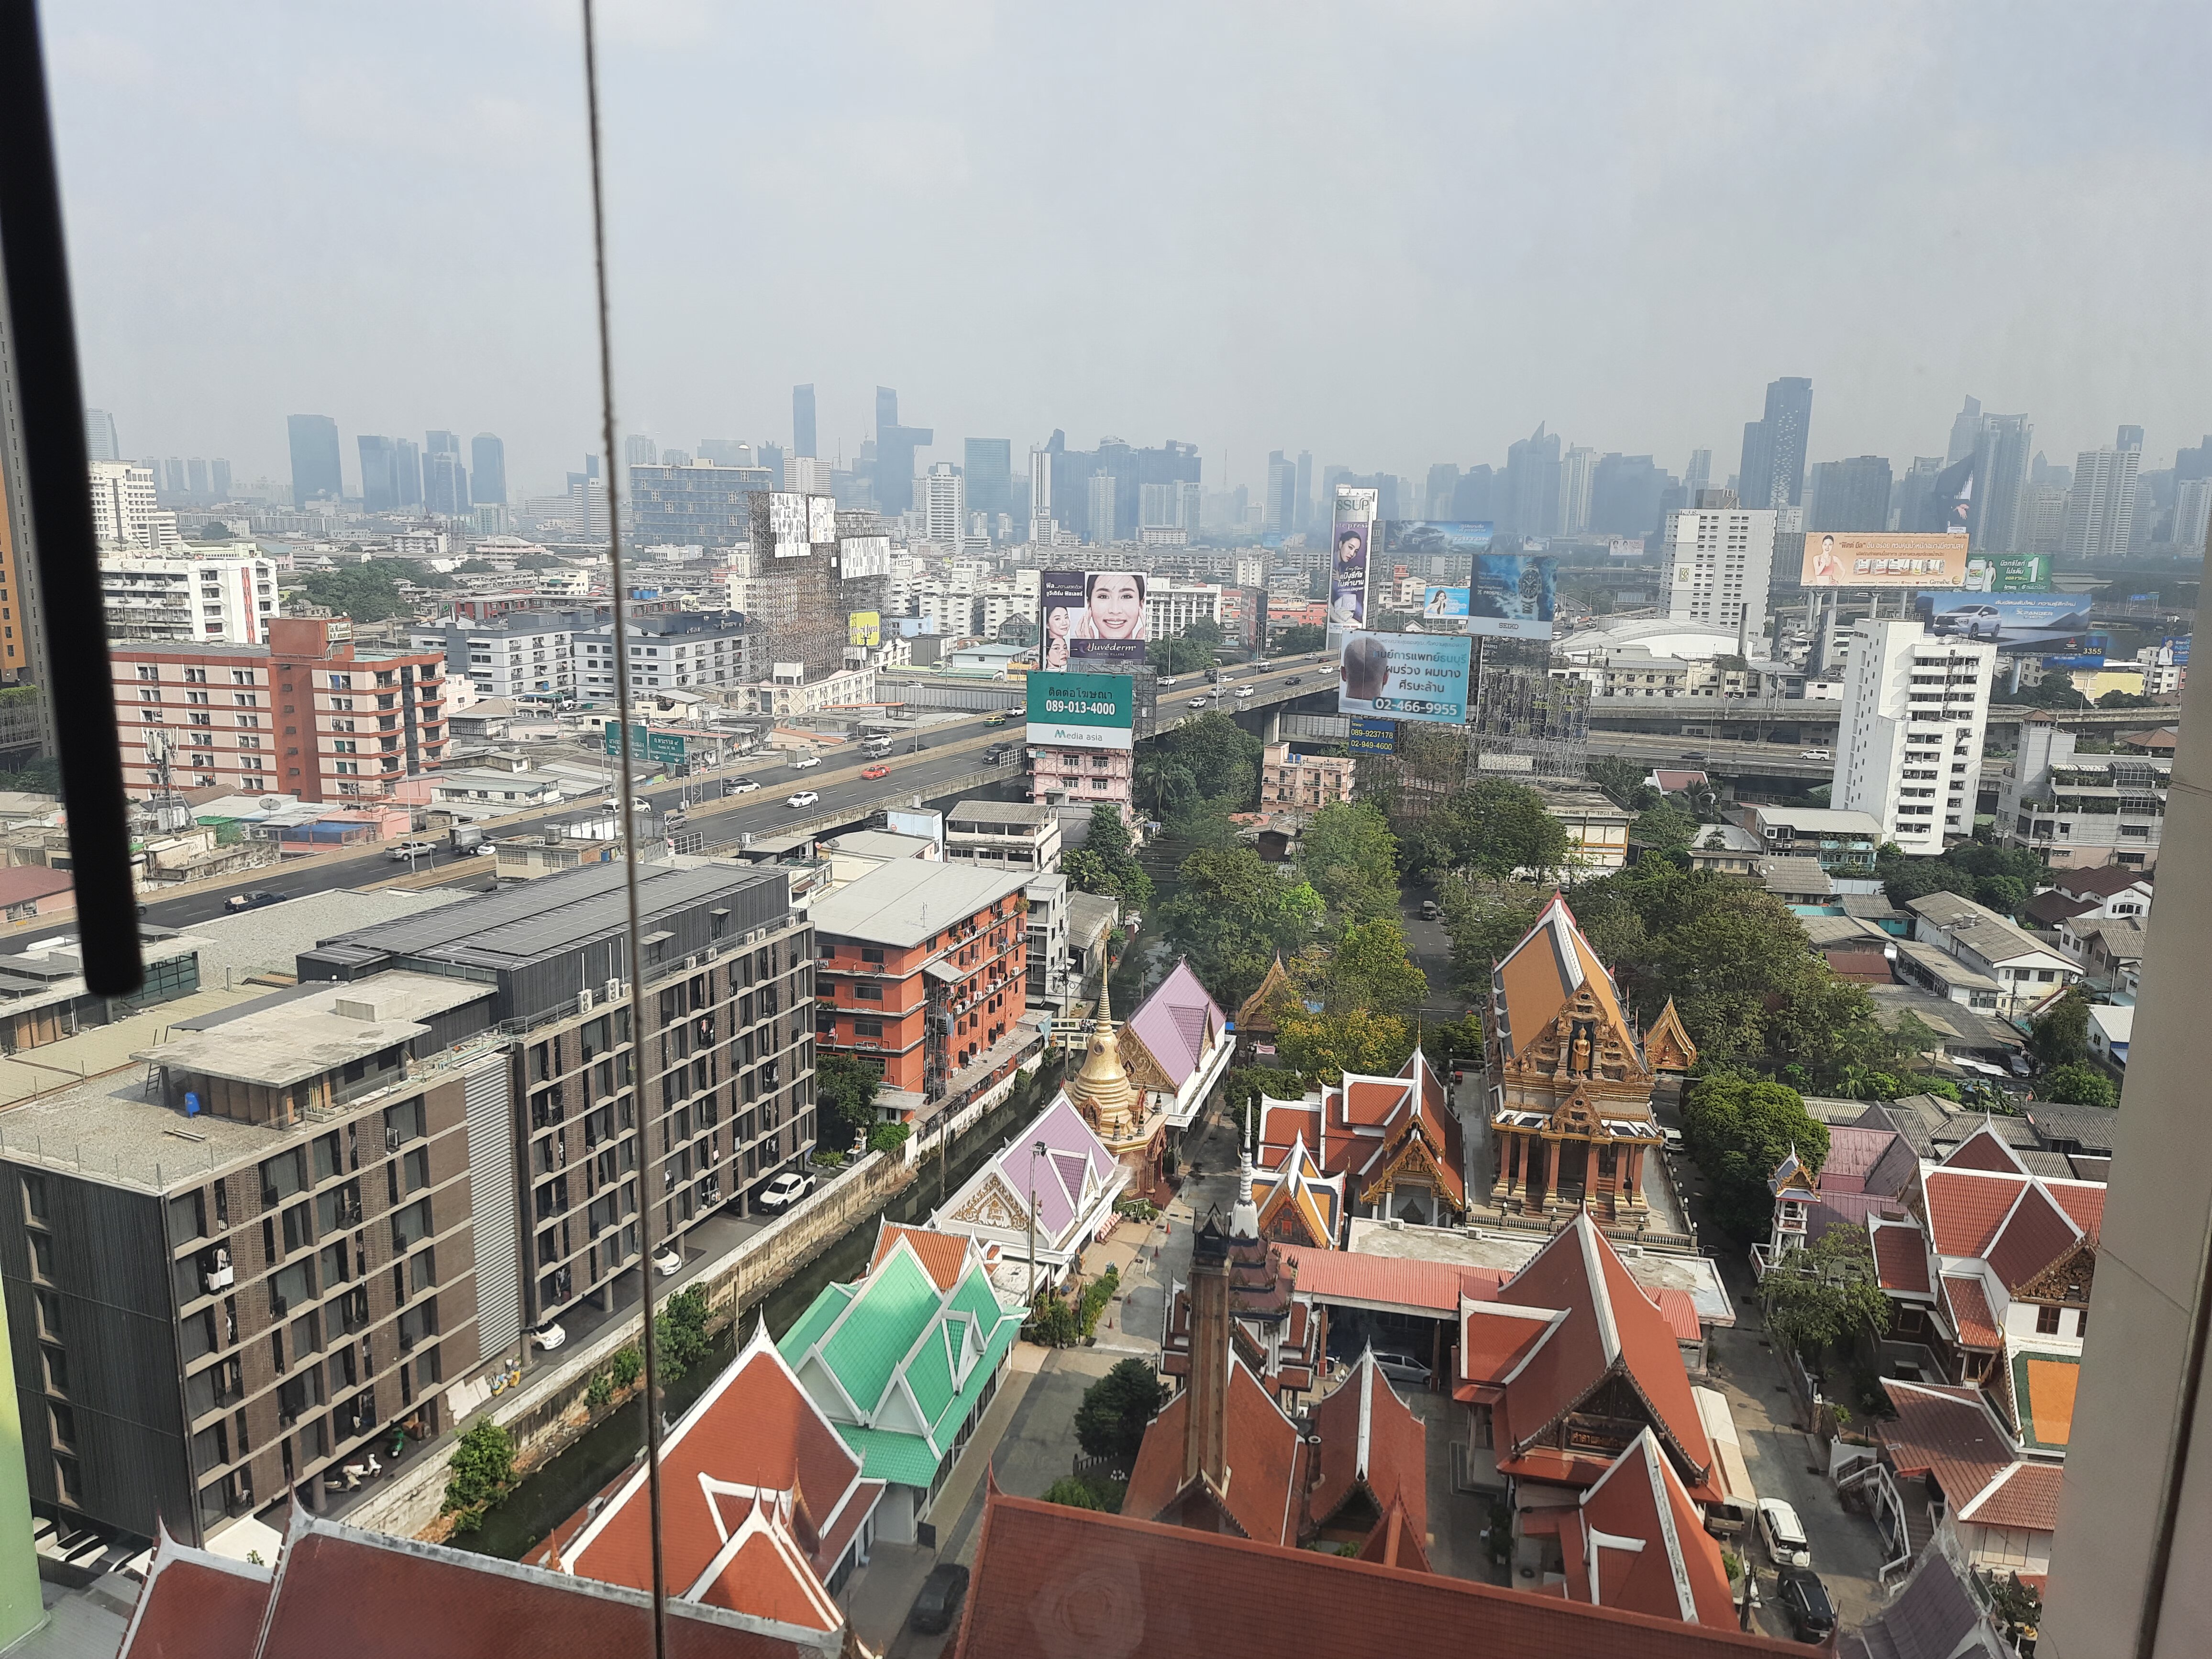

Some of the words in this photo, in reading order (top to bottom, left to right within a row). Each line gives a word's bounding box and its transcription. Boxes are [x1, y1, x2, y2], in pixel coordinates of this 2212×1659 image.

[2028, 557, 2039, 583] 1
[1386, 664, 1421, 675] ผมร่วง
[1425, 669, 1461, 678] ผมบาง
[1049, 687, 1113, 699] ติดต่อโฆษณา
[1399, 679, 1445, 693] ศีรษะล้าน
[1046, 699, 1116, 716] 089-013-4000
[1375, 698, 1458, 716] 02-466-9955
[1054, 729, 1084, 740] Media
[1351, 729, 1394, 739] 089-9237178
[1351, 740, 1393, 751] 02-949-4600
